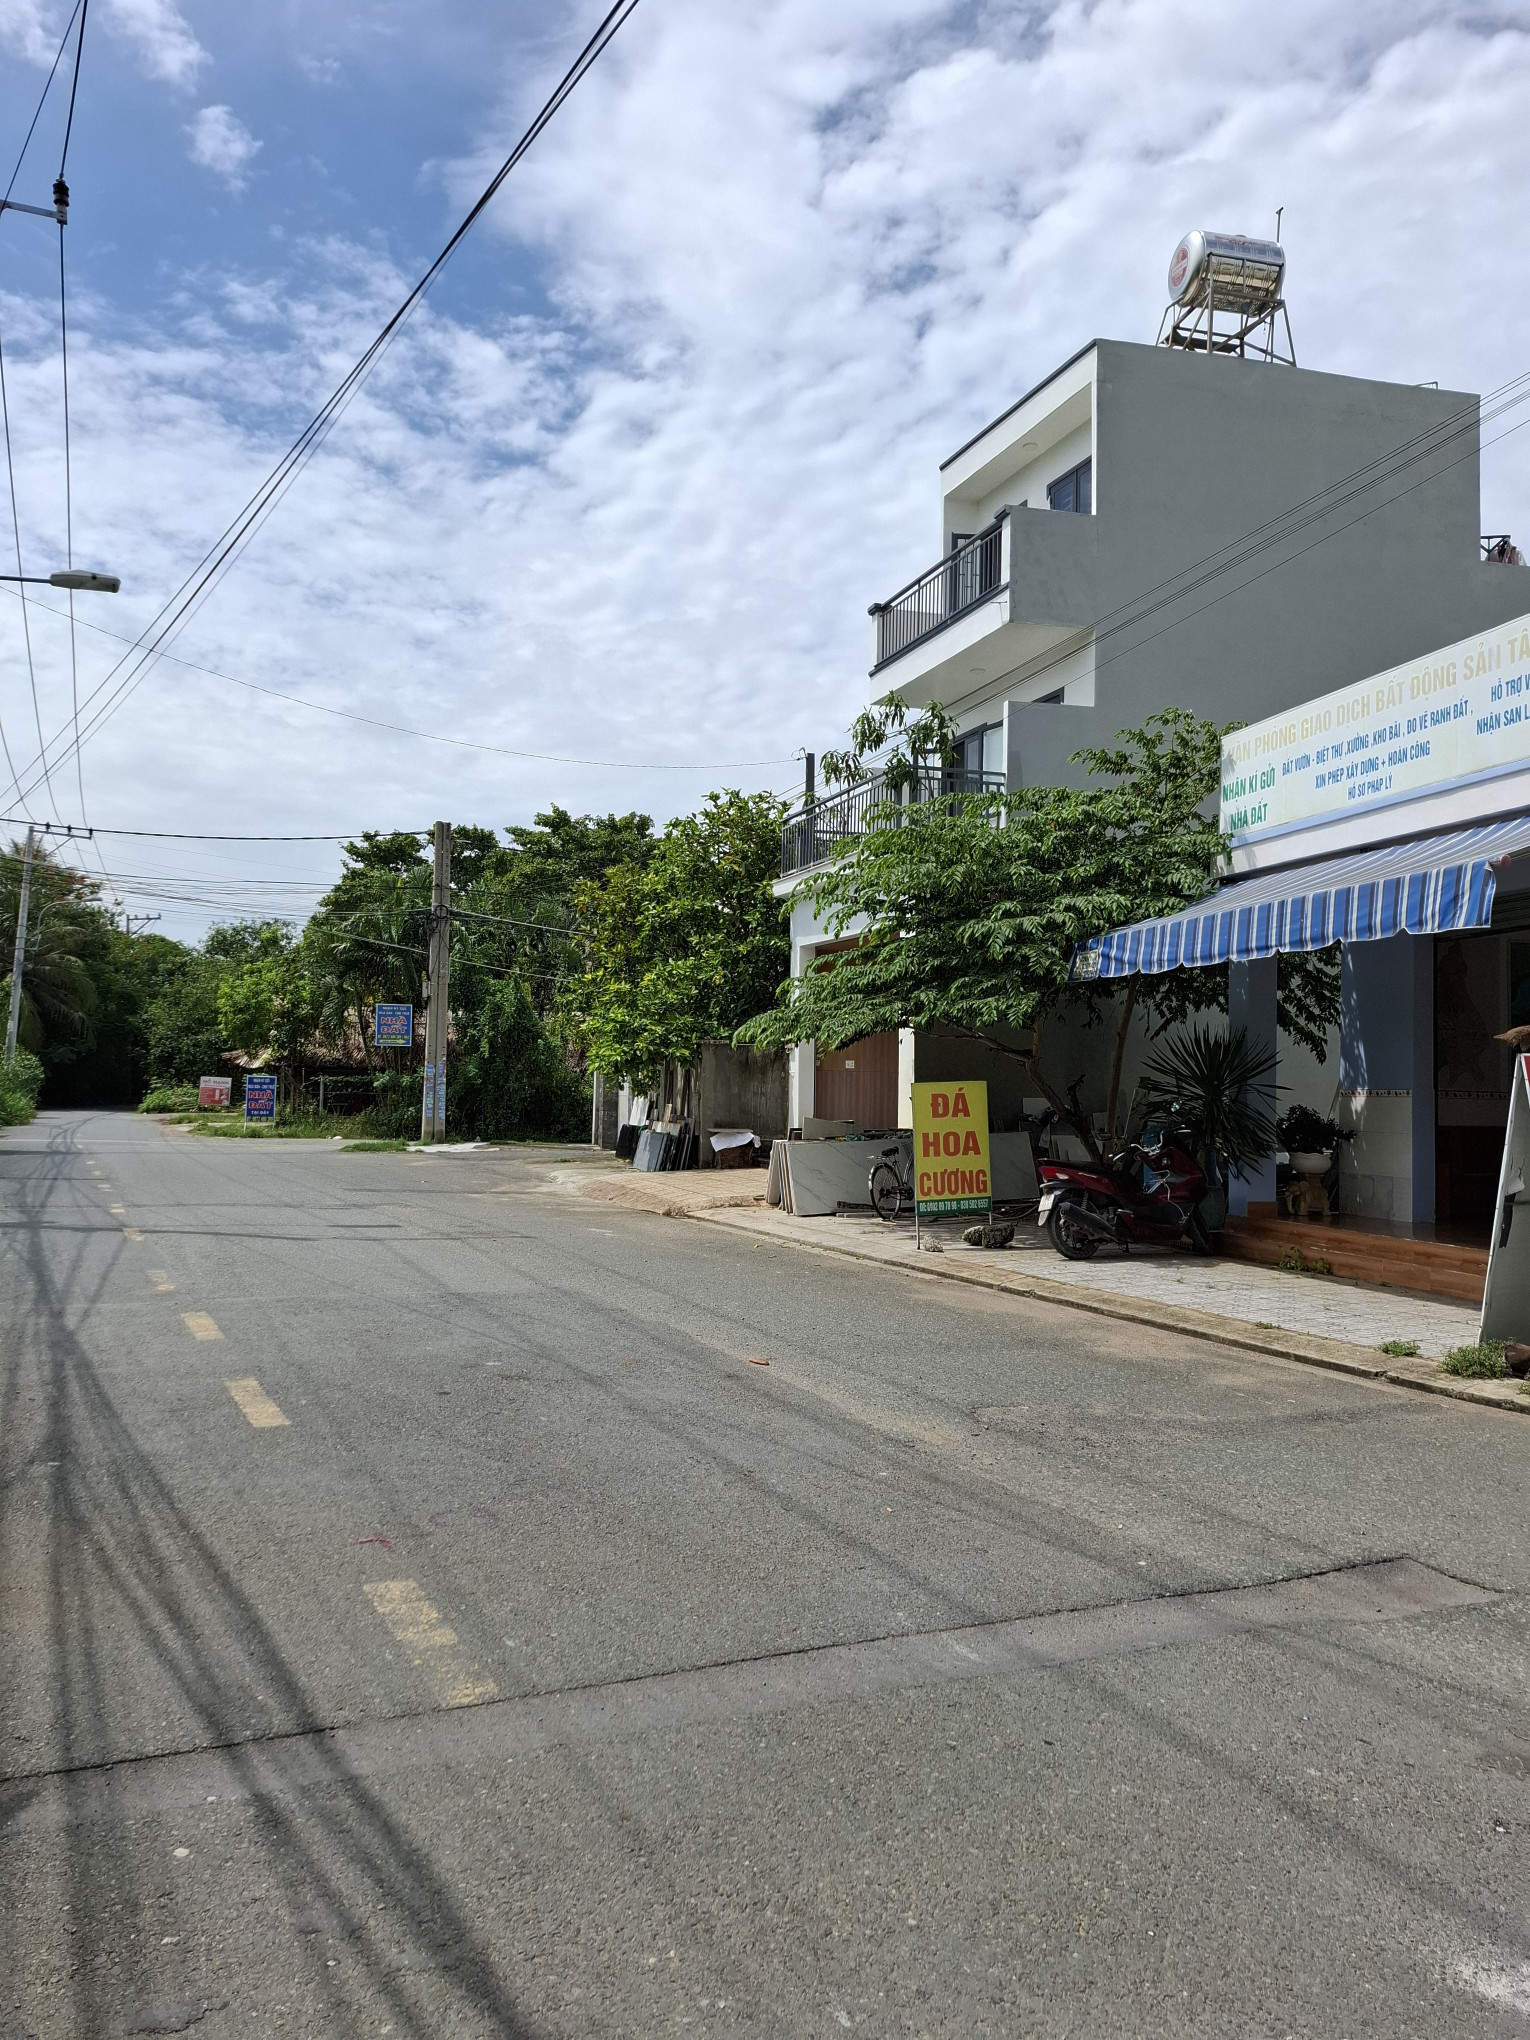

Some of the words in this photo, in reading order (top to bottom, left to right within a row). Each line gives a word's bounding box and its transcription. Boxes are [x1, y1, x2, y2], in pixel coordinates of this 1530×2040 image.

[1505, 674, 1523, 698] TRỢ
[1255, 723, 1297, 757] PHÒNG
[1300, 709, 1331, 741] GIAO
[1336, 694, 1370, 728] DỊCH
[1375, 675, 1405, 714] BẤT
[1410, 662, 1457, 701] ĐỘNG
[1430, 705, 1451, 727] RANH
[1476, 711, 1501, 736] NHẬN
[1503, 705, 1522, 727] SAN
[1315, 774, 1326, 790] XIN
[1327, 764, 1344, 785] PHÉP
[1345, 760, 1359, 781] XÂY
[1410, 740, 1431, 761] CÔNG
[1222, 777, 1246, 803] NHẬN
[1251, 797, 1268, 825] ĐẤT
[380, 1016, 408, 1024] NHÀ
[380, 1024, 408, 1034] ĐẤT
[248, 1089, 273, 1099] NHÀ
[248, 1099, 273, 1109] ĐẤT
[930, 1087, 971, 1118] ĐÁ
[921, 1130, 981, 1157] HOA
[919, 1168, 988, 1197] CƯƠNG
